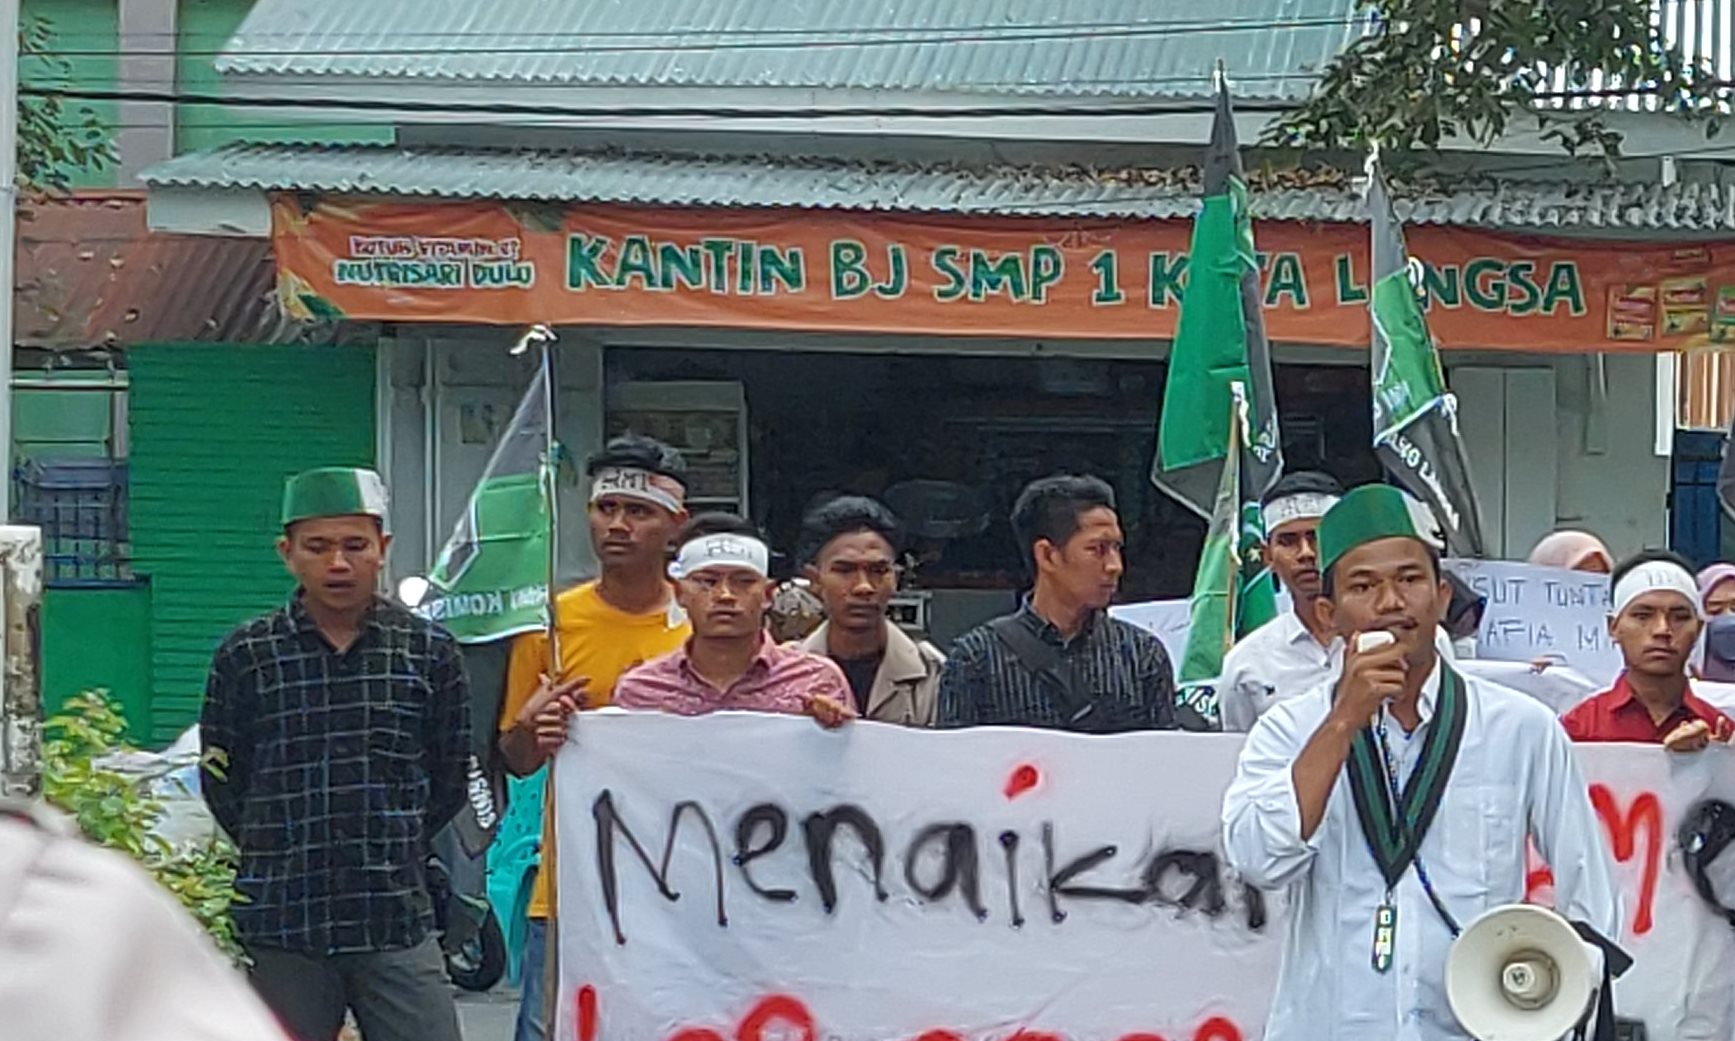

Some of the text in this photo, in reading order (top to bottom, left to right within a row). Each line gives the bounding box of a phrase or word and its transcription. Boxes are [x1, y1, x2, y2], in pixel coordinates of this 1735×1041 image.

[565, 231, 805, 295] KANTIN
[828, 241, 909, 301] BJ
[933, 246, 1064, 306] SMP
[1090, 249, 1123, 307] 1
[1335, 252, 1587, 317] LNGSA
[1480, 618, 1553, 647] AFIA
